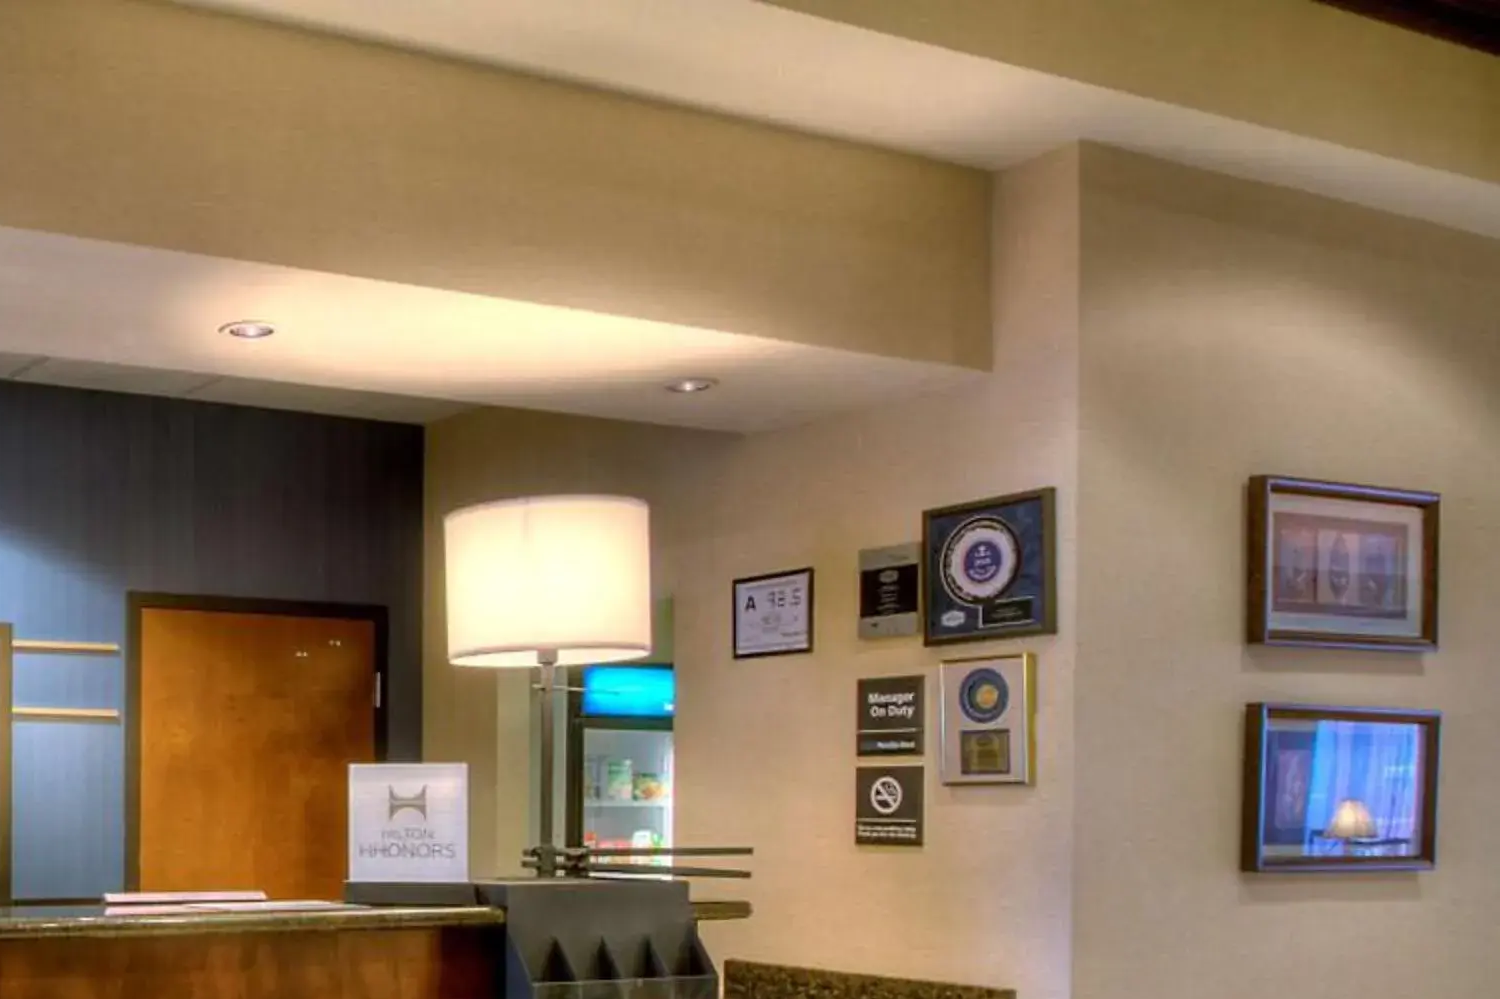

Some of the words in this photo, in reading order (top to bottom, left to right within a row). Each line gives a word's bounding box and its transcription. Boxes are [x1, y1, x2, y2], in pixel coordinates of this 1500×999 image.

[745, 594, 757, 612] A
[868, 692, 915, 705] Manager
[869, 705, 886, 718] On
[887, 704, 915, 719] Duty
